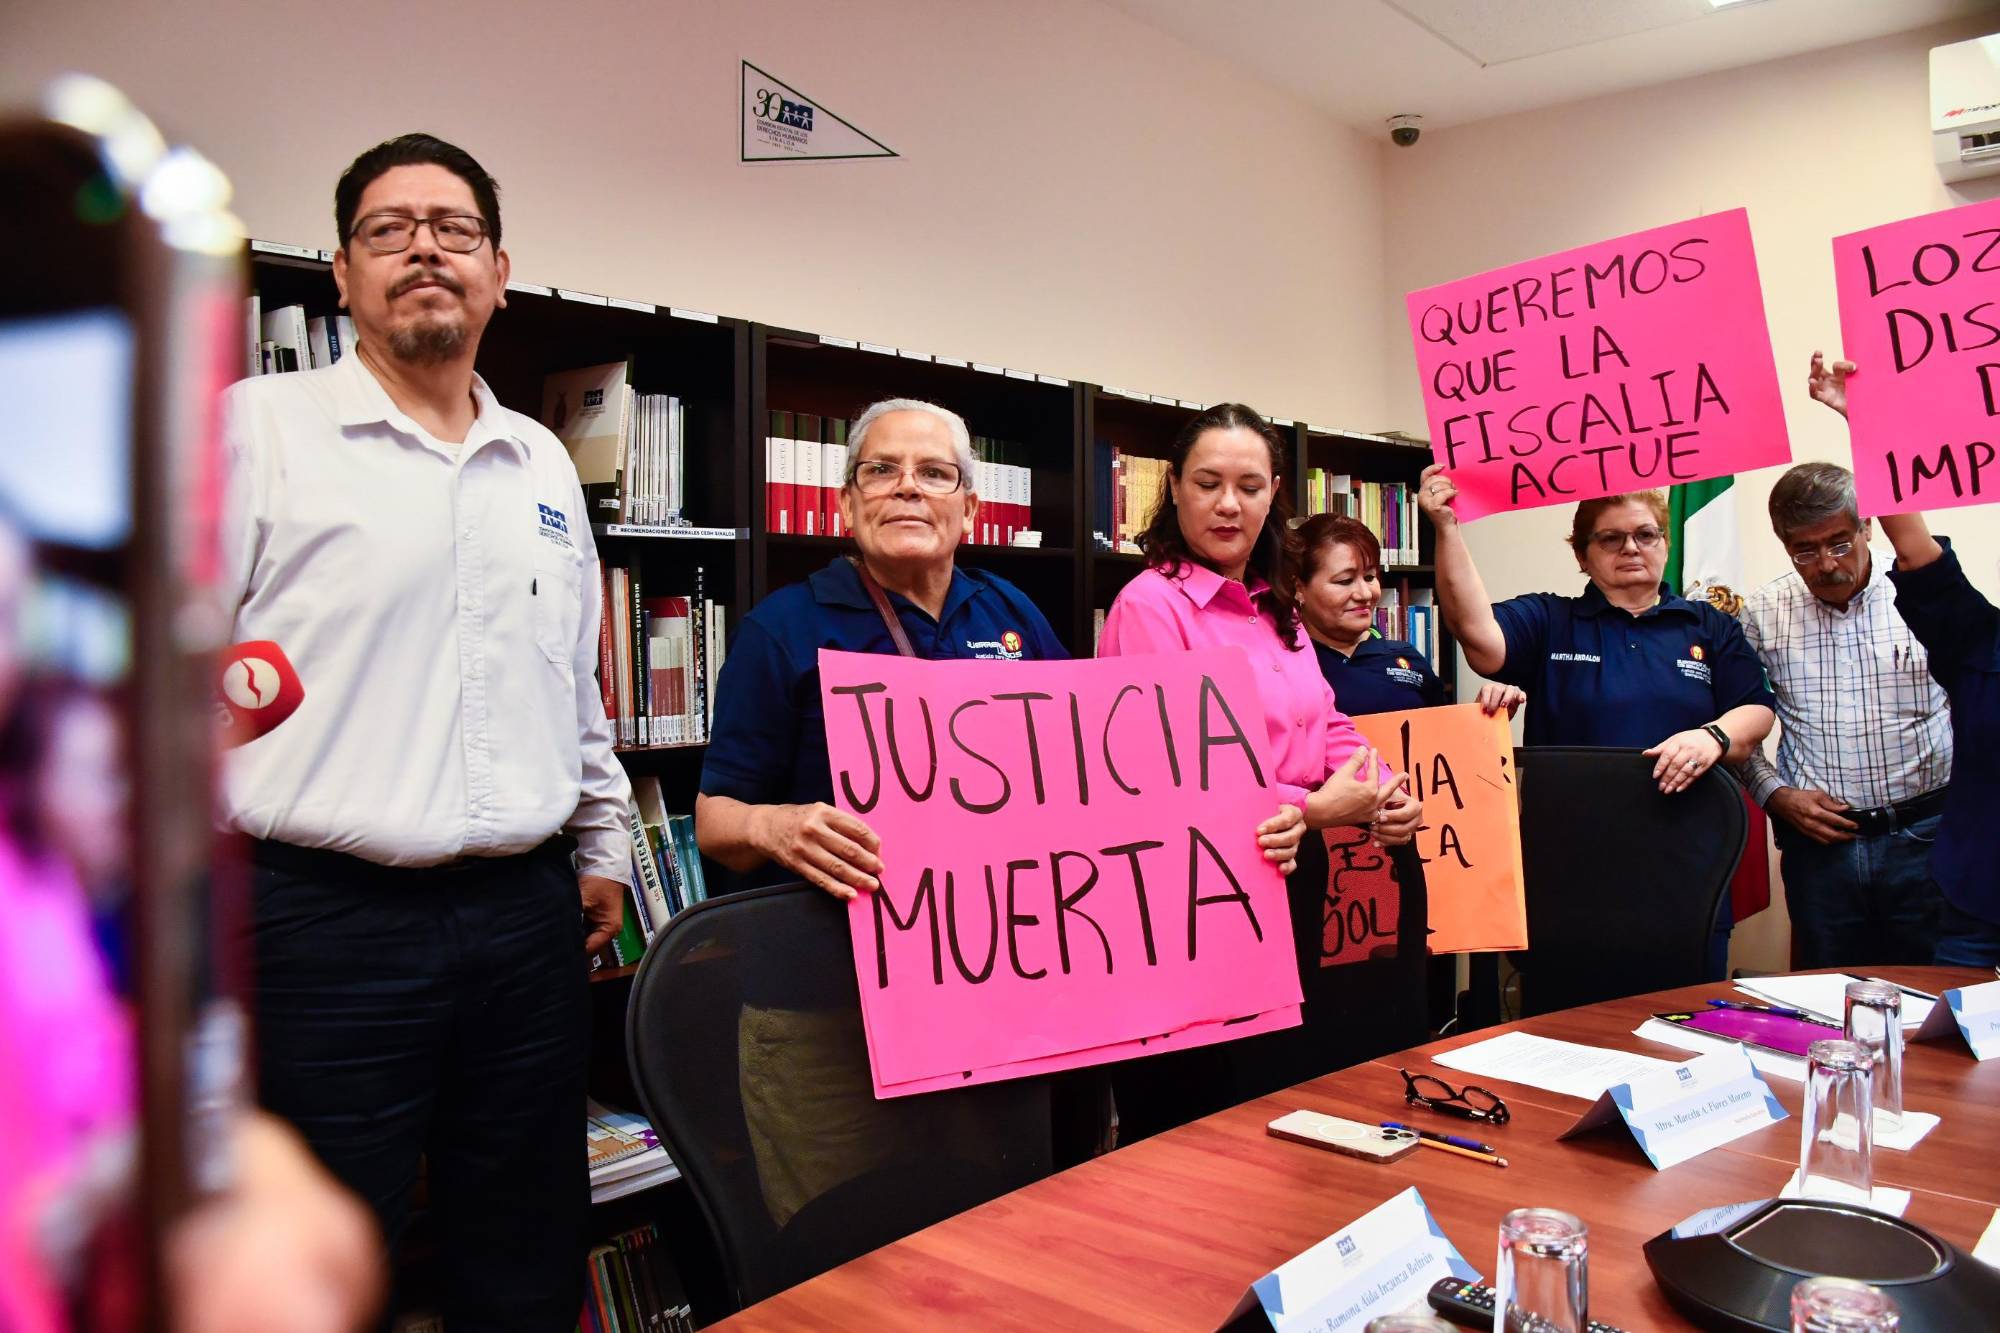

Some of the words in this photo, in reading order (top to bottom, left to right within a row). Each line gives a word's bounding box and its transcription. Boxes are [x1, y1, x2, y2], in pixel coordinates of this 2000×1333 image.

[753, 88, 783, 121] 30
[1420, 238, 1709, 346] QUEREMOS
[1433, 348, 1517, 402] QUE
[1559, 325, 1631, 380] LA
[1443, 362, 1731, 470] FISCALIA
[1510, 430, 1700, 505] ACTUE
[620, 527, 671, 535] RECOMENDACIONES
[671, 529, 700, 537] GENERALES
[634, 583, 642, 628] MIGRANTES
[1550, 652, 1573, 661] MARTHA
[831, 675, 1268, 815] JUSTICIA
[871, 826, 1264, 989] MUERTA
[1673, 1107, 1701, 1125] Marcela
[1708, 1099, 1729, 1113] Flores
[1727, 1090, 1752, 1104] Moreno
[1325, 1302, 1362, 1333] Ramona
